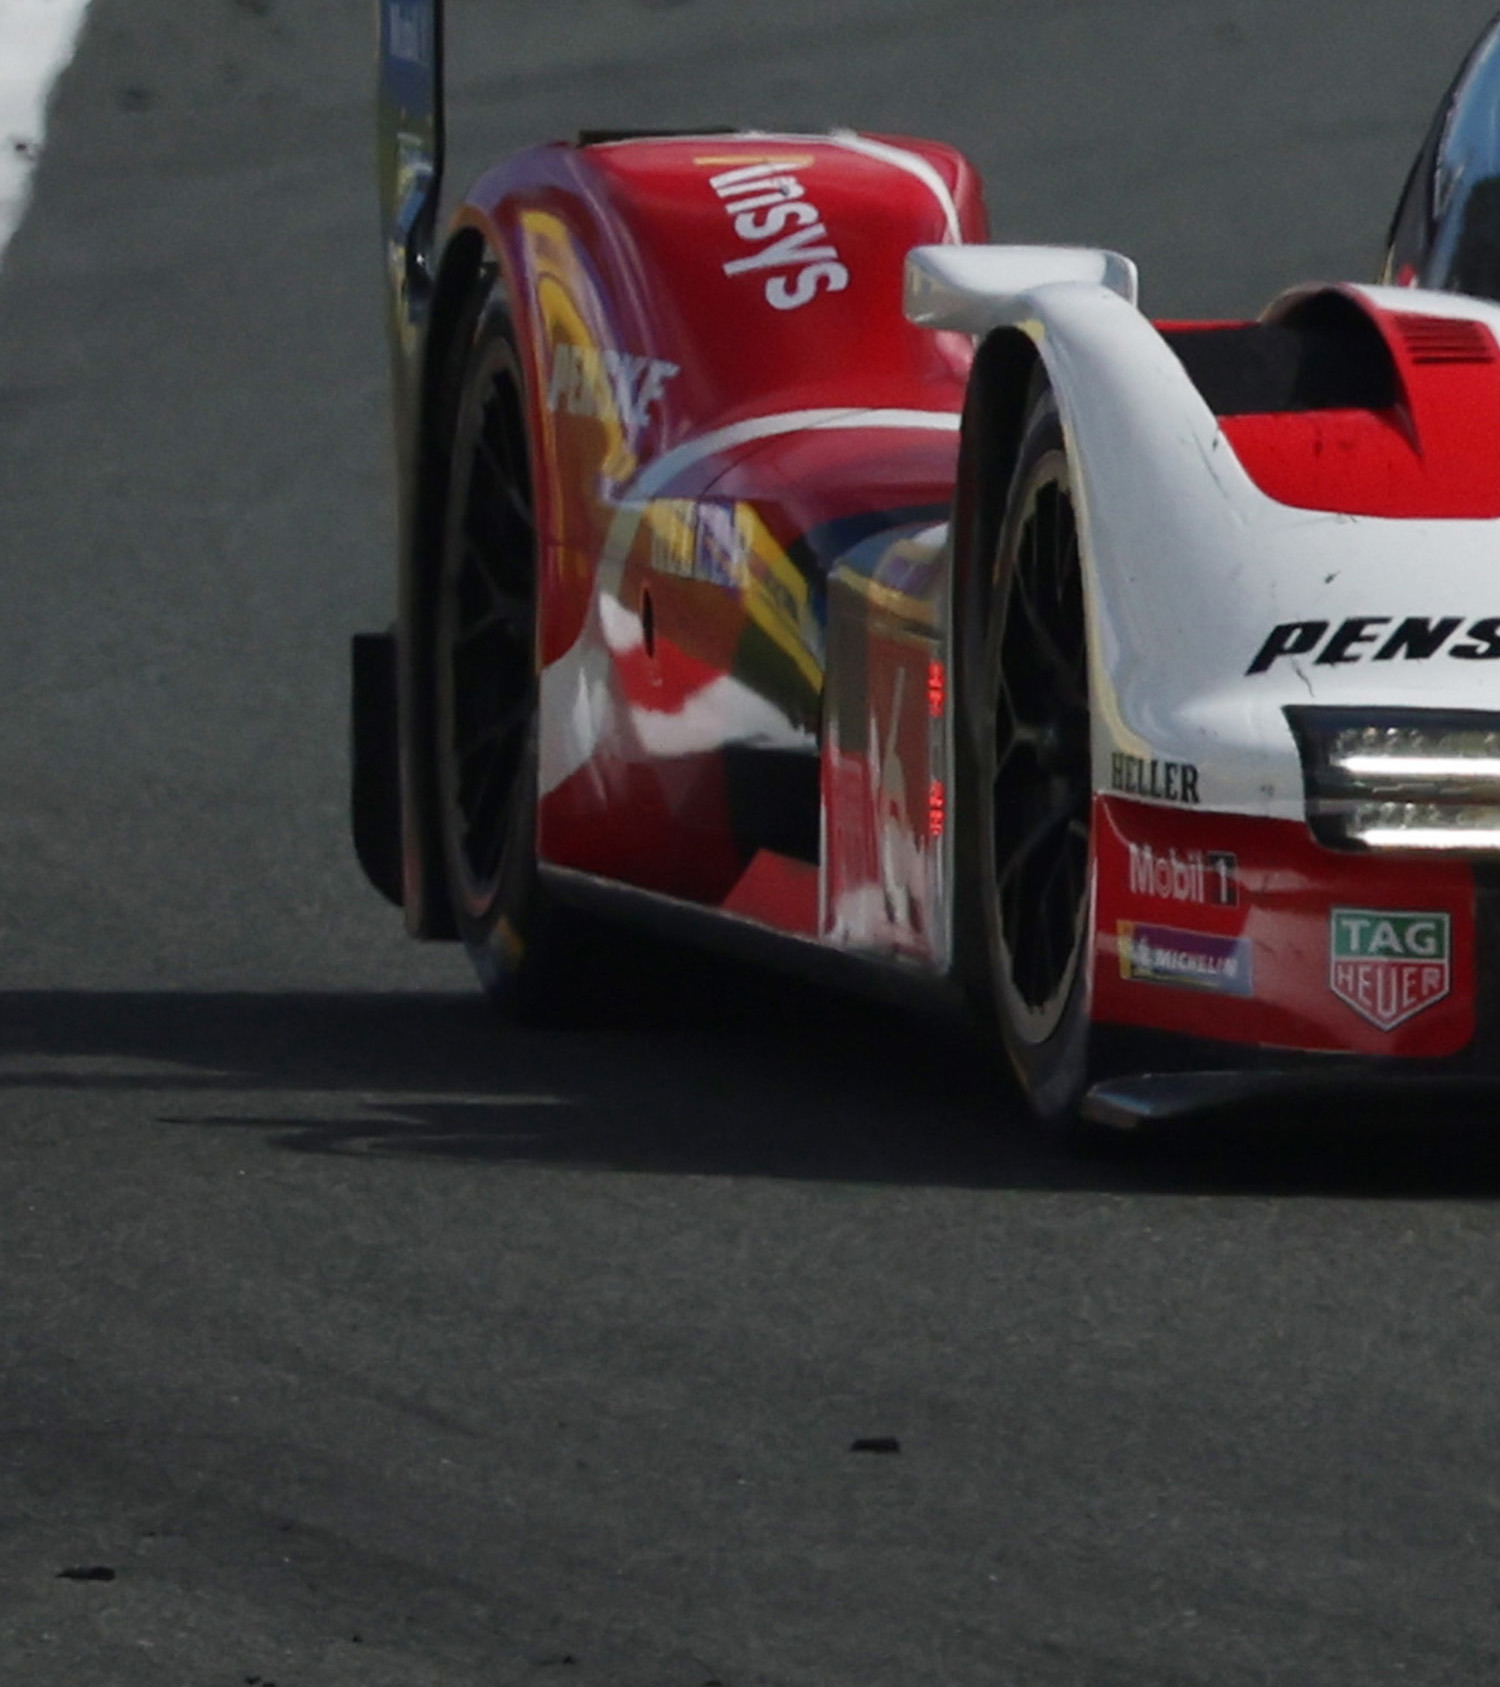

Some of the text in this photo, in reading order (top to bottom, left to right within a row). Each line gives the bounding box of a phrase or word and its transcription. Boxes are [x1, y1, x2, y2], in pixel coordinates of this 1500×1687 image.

[694, 155, 849, 310] Ansys
[1129, 842, 1203, 904] Mobil
[1150, 944, 1238, 978] MICHELIN
[1340, 918, 1437, 956] TAG
[1336, 965, 1441, 1020] HEUER
